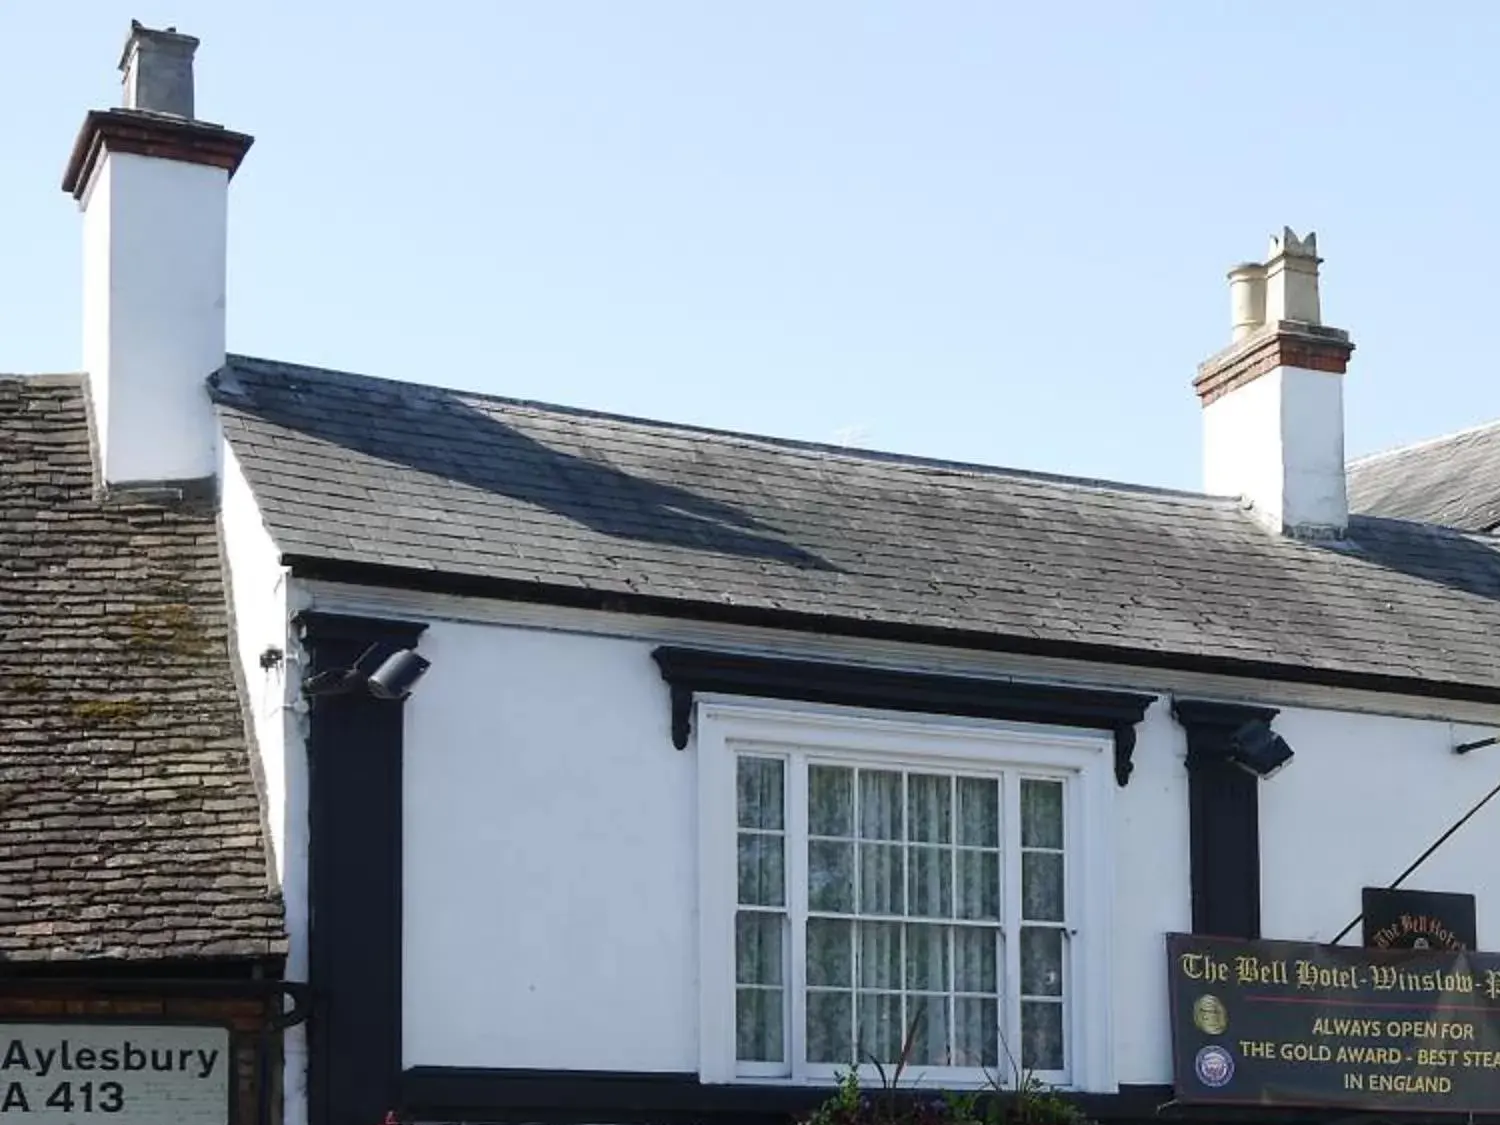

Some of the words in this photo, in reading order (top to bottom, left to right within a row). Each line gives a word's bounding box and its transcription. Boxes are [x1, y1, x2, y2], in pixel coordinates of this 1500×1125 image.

[1181, 953, 1230, 983] The
[1235, 956, 1288, 985] Bell
[1312, 1018, 1381, 1037] ALWAYS
[1387, 1020, 1437, 1039] OPEN
[1441, 1022, 1474, 1040] FOR
[1, 1039, 219, 1078] Aylesbury
[1239, 1040, 1275, 1059] THE
[1280, 1043, 1331, 1062] GOLD
[1336, 1047, 1401, 1065] AWARD
[1417, 1049, 1459, 1066] BEST
[1, 1081, 31, 1112] A
[45, 1081, 125, 1113] 413
[1344, 1073, 1363, 1090] IN
[1369, 1075, 1452, 1093] ENGLAND
